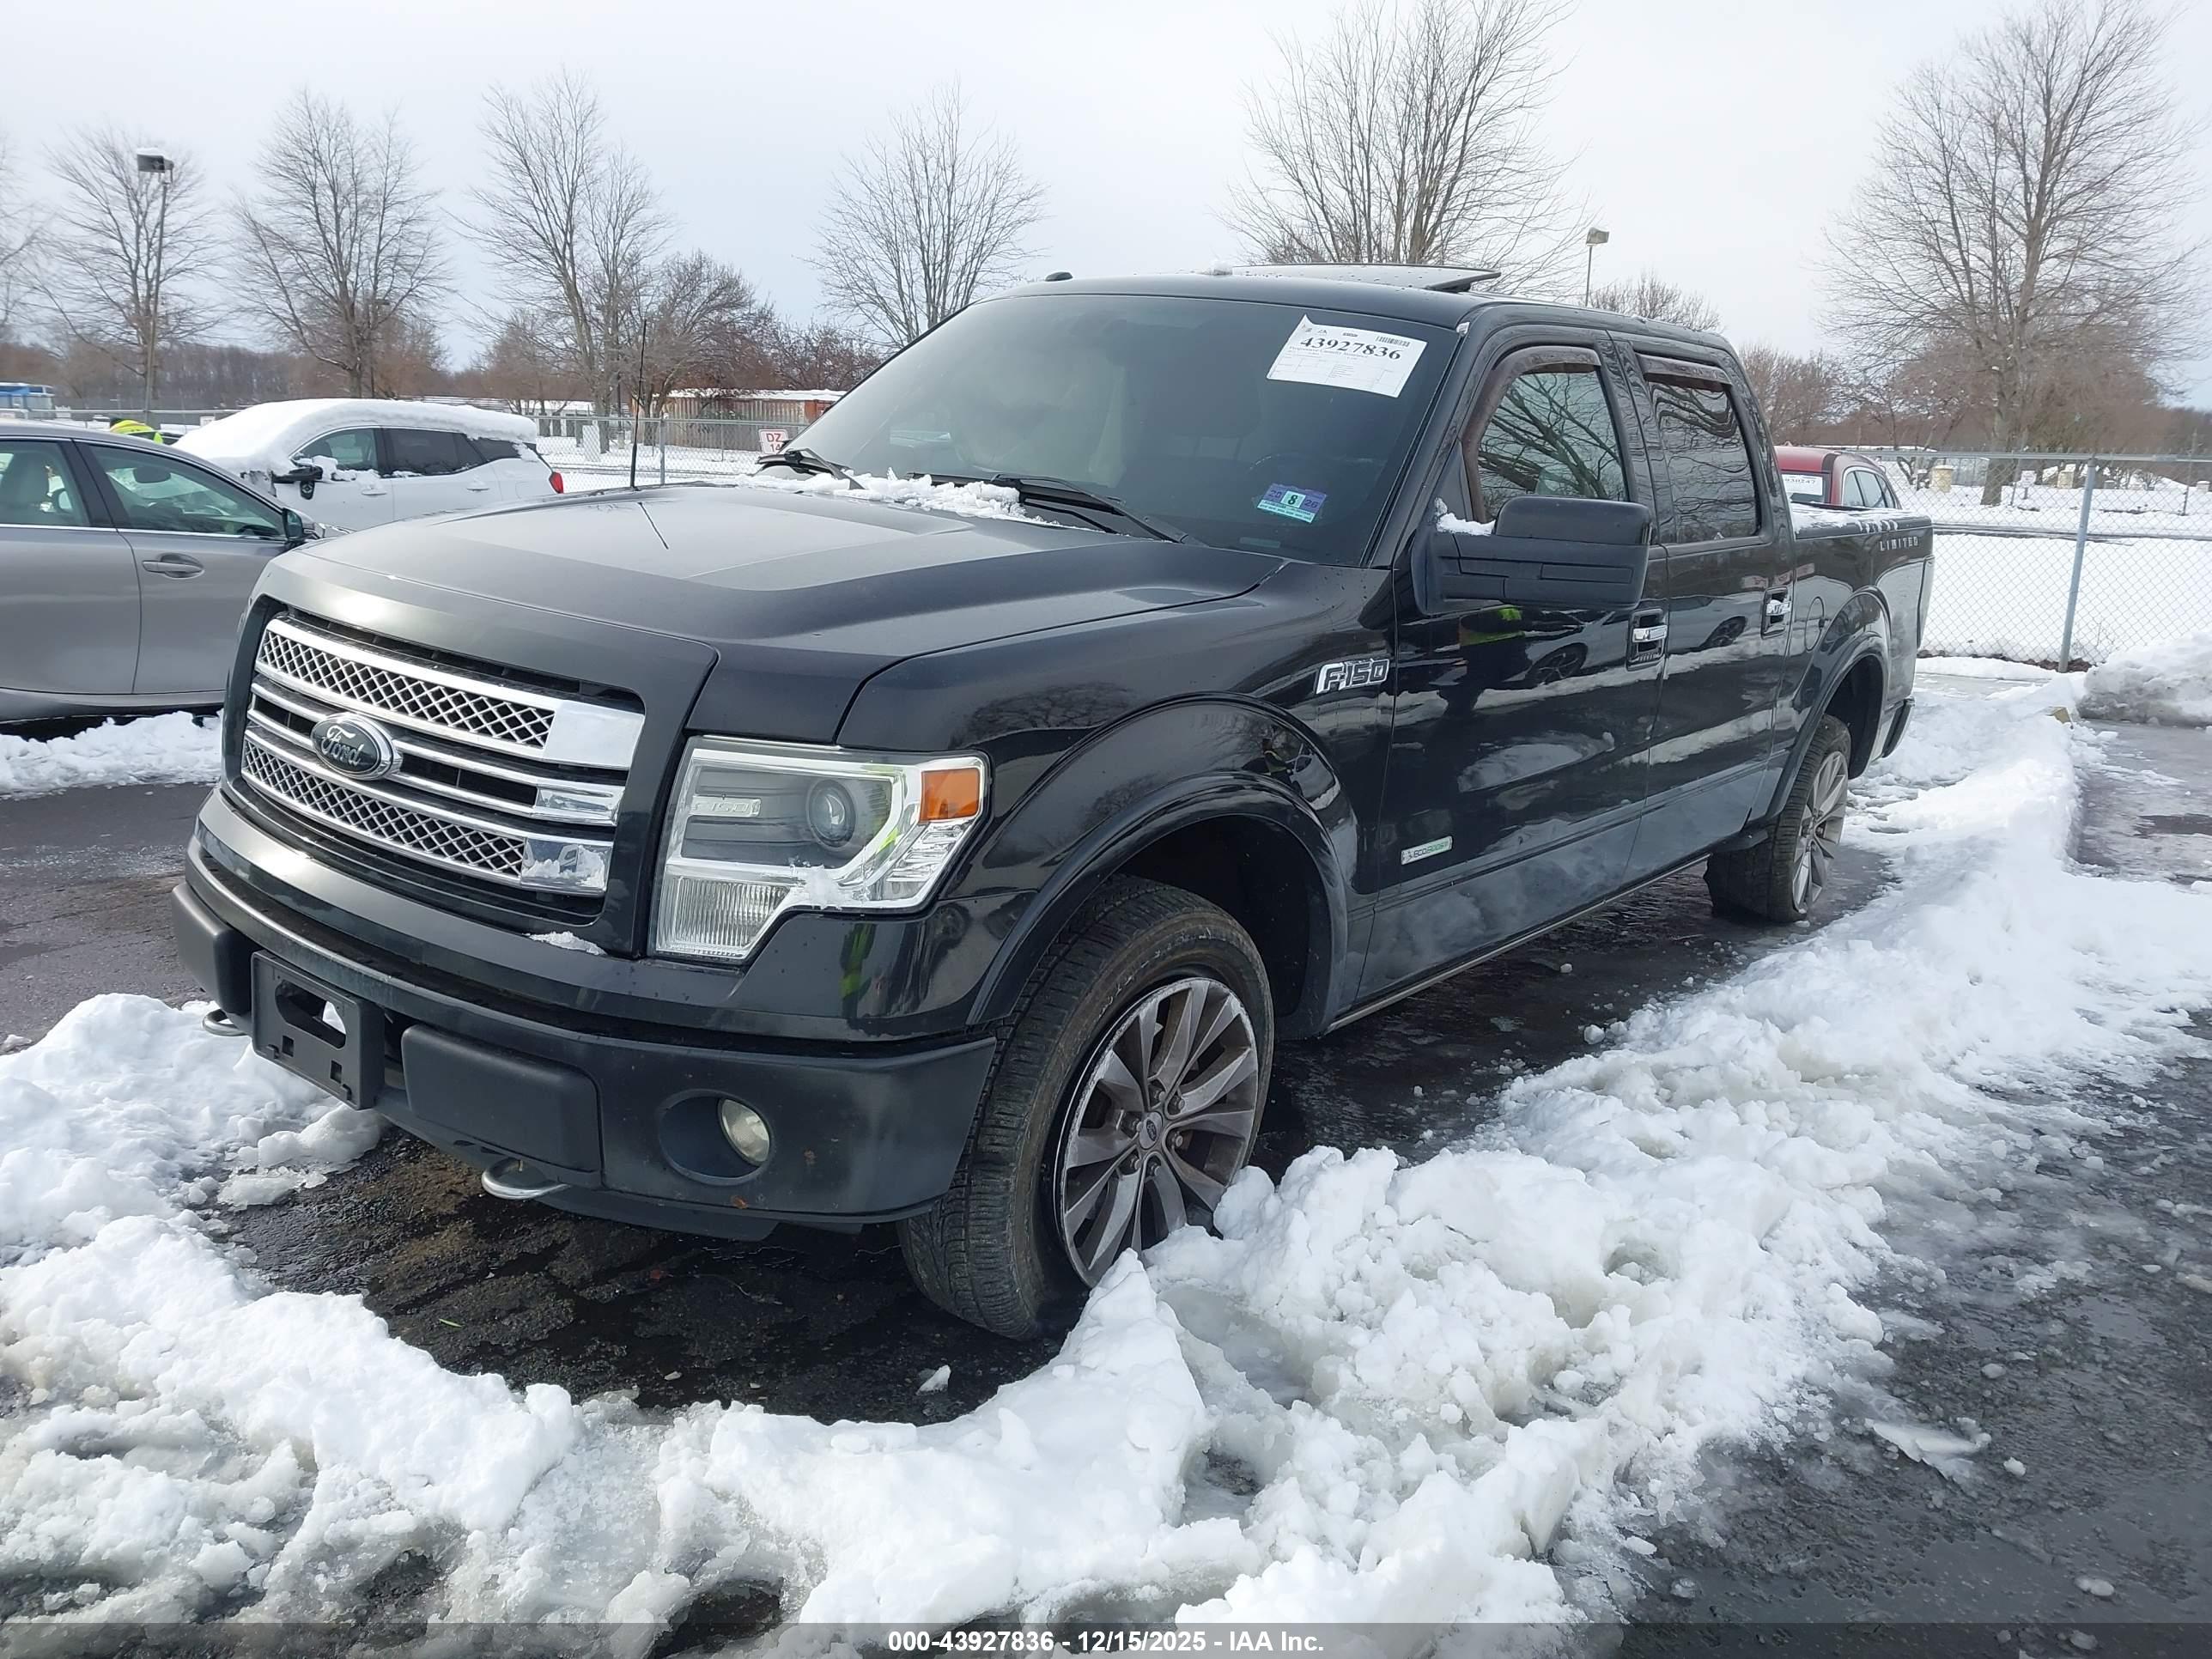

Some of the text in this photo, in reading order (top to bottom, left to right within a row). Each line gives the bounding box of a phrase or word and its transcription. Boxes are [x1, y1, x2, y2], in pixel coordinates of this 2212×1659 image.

[1300, 337, 1402, 361] 43927836
[766, 433, 781, 442] DZ
[1288, 495, 1297, 505] 8
[1880, 536, 1917, 551] LIMITED
[321, 725, 364, 766] Ford
